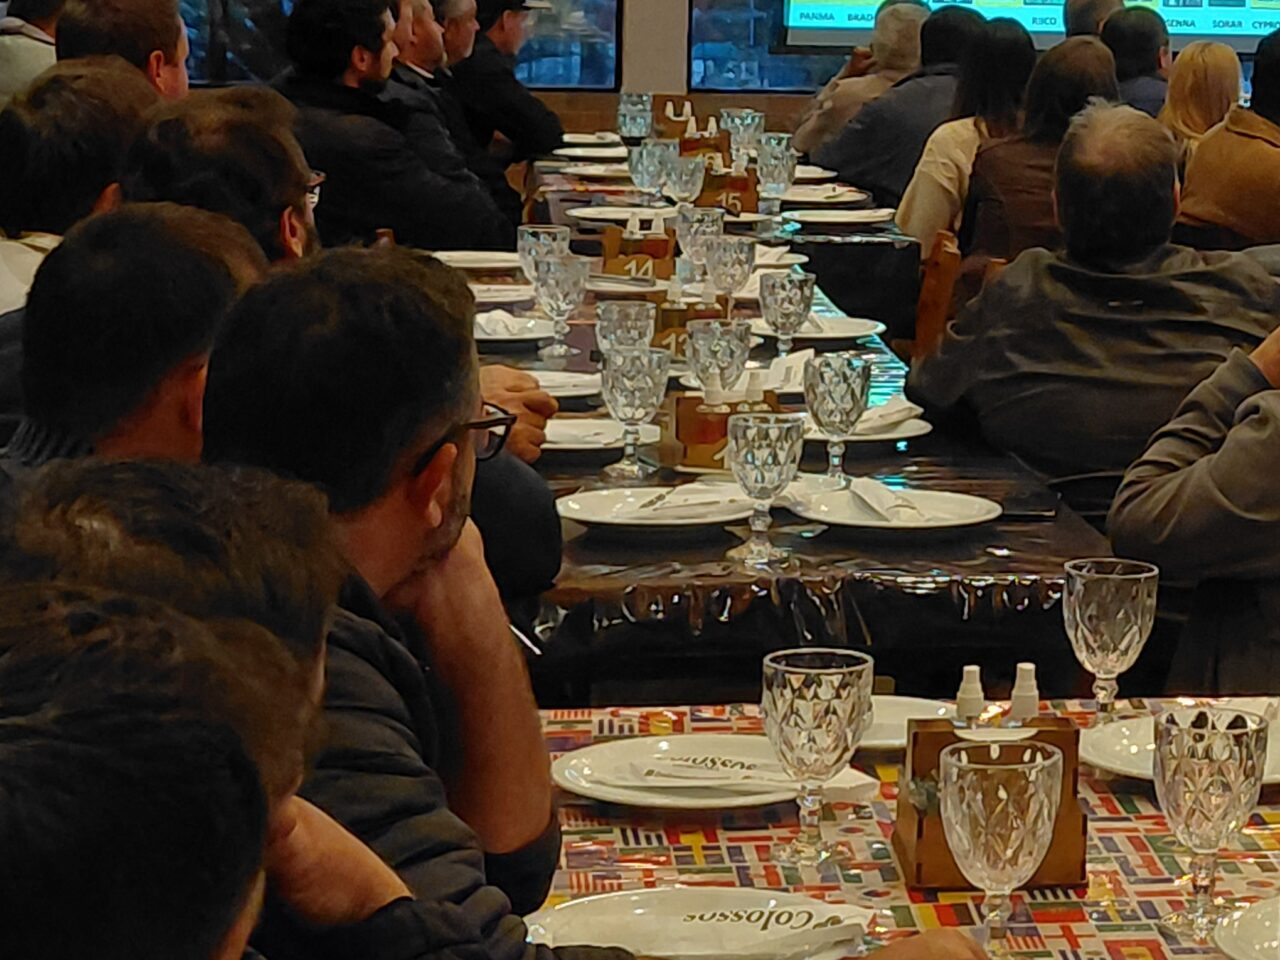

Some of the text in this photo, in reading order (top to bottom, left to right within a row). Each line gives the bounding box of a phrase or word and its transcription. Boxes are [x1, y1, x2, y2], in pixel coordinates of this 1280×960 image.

[847, 13, 874, 22] BRAD
[716, 192, 742, 212] 15
[624, 259, 653, 278] 14
